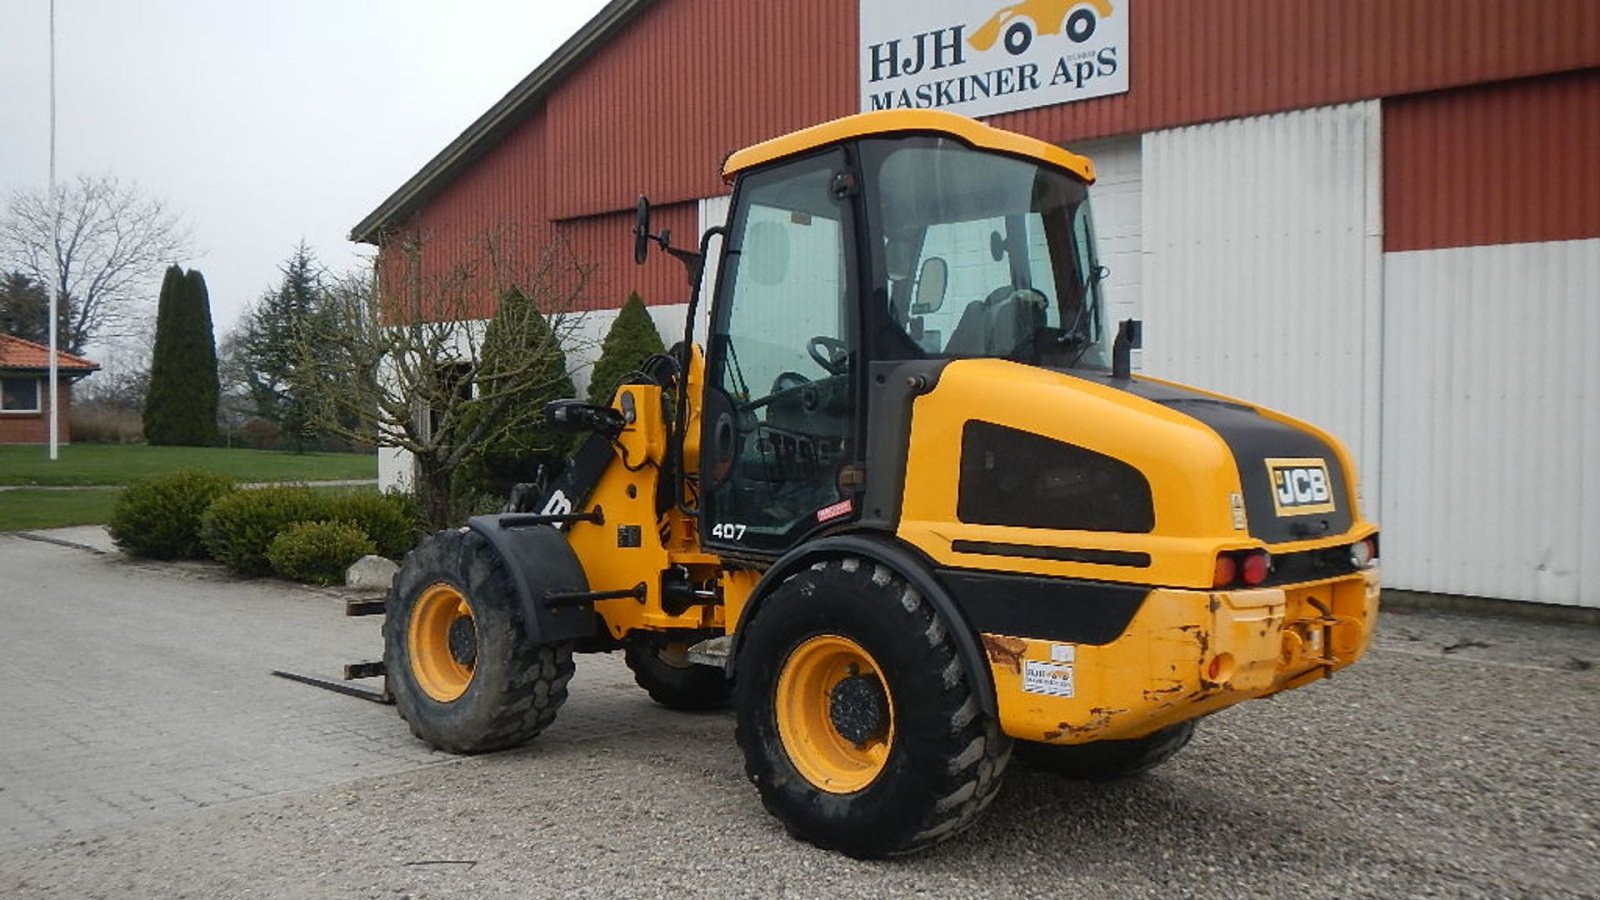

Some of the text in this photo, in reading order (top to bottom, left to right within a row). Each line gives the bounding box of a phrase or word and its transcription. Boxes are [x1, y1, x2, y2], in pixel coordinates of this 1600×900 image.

[868, 24, 966, 83] HJH
[869, 47, 1118, 112] MASKINER ApS
[1278, 468, 1330, 505] JCB
[712, 523, 747, 541] 407
